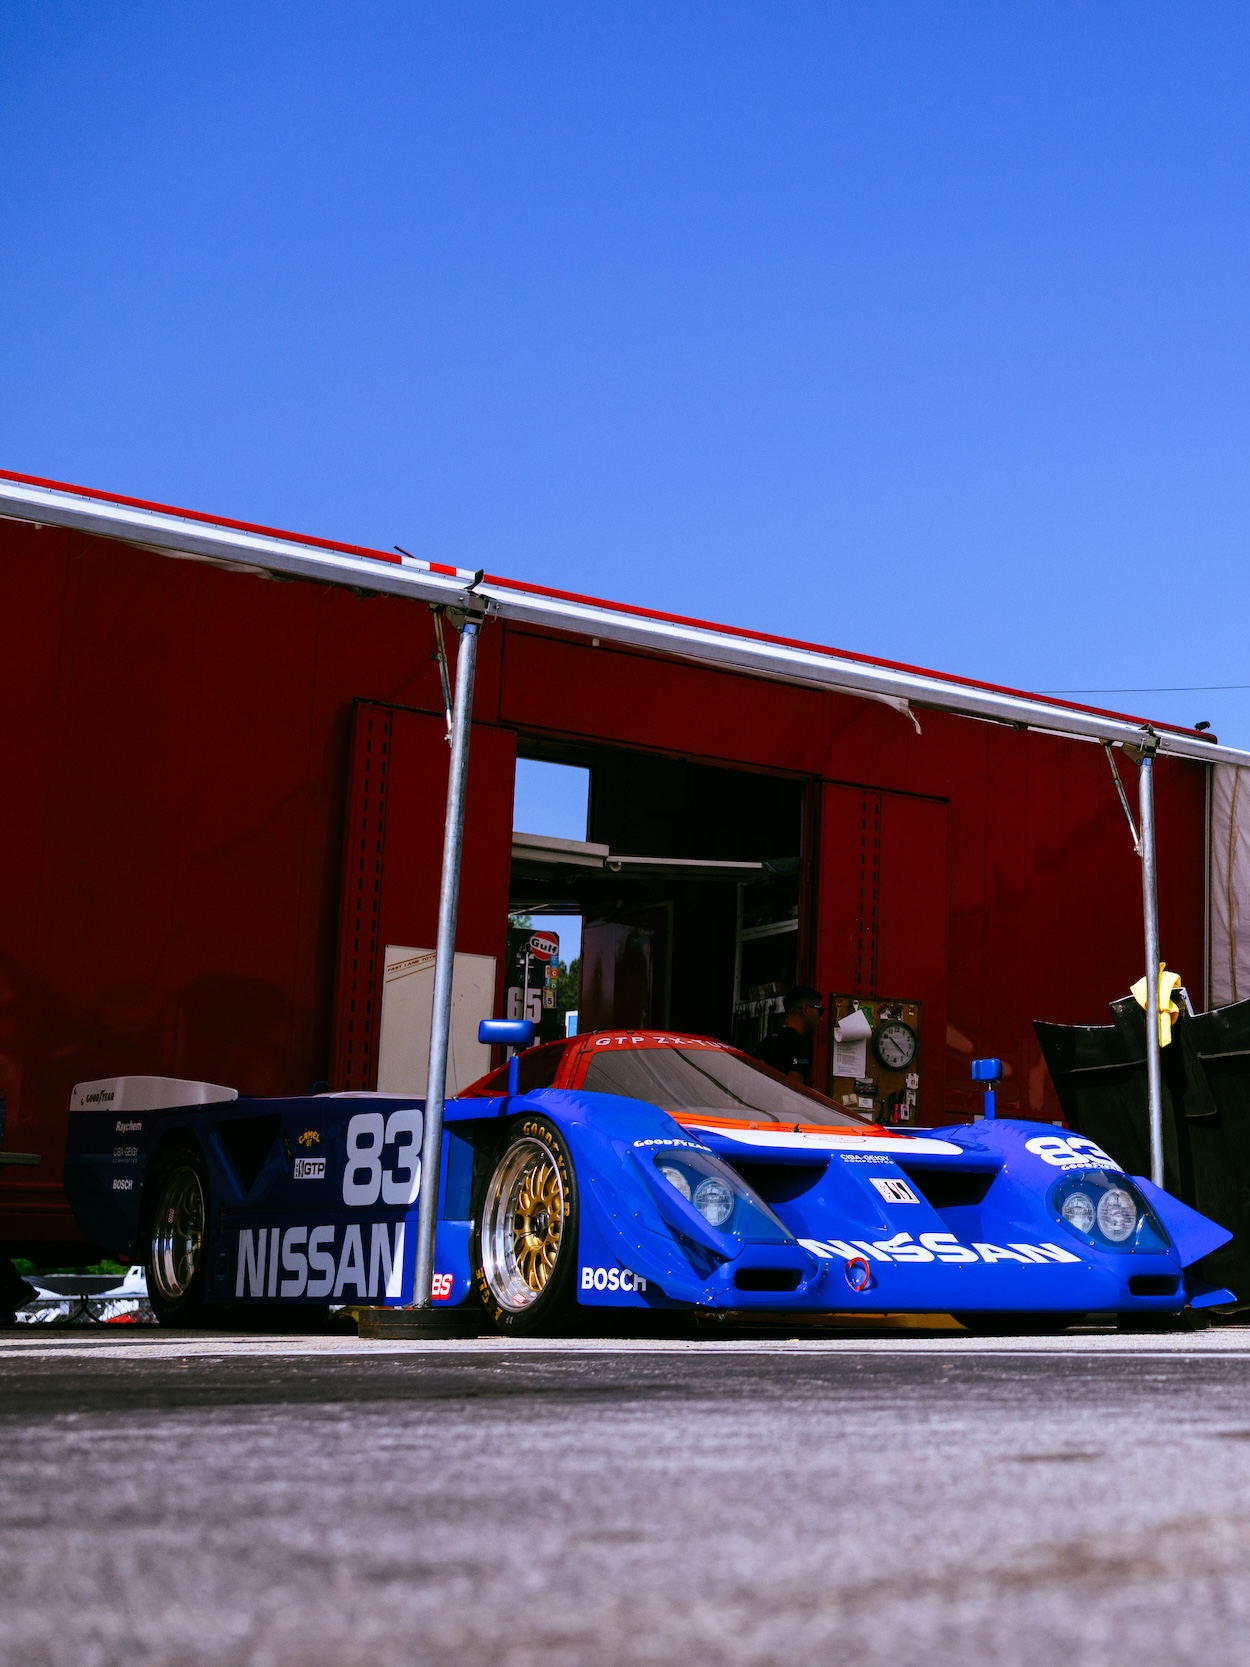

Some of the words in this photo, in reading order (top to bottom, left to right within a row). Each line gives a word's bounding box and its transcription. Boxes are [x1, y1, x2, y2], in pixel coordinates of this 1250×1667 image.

[531, 938, 557, 954] Gulf
[507, 986, 541, 1024] 65
[596, 1037, 645, 1046] GTP
[86, 1090, 114, 1104] GOODYEAR
[116, 1121, 142, 1133] Raychem
[298, 1131, 320, 1144] CAMEL
[633, 1139, 712, 1152] GOODYEAR
[342, 1109, 424, 1206] 83
[840, 1153, 890, 1161] CIBA-GEIGY
[1025, 1136, 1125, 1172] 83
[304, 1162, 325, 1175] GTP
[112, 1179, 133, 1190] BOSCH
[796, 1232, 1082, 1263] NISSAN
[235, 1222, 405, 1298] NISSAN
[432, 1273, 454, 1299] BS
[581, 1267, 647, 1292] BOSCH
